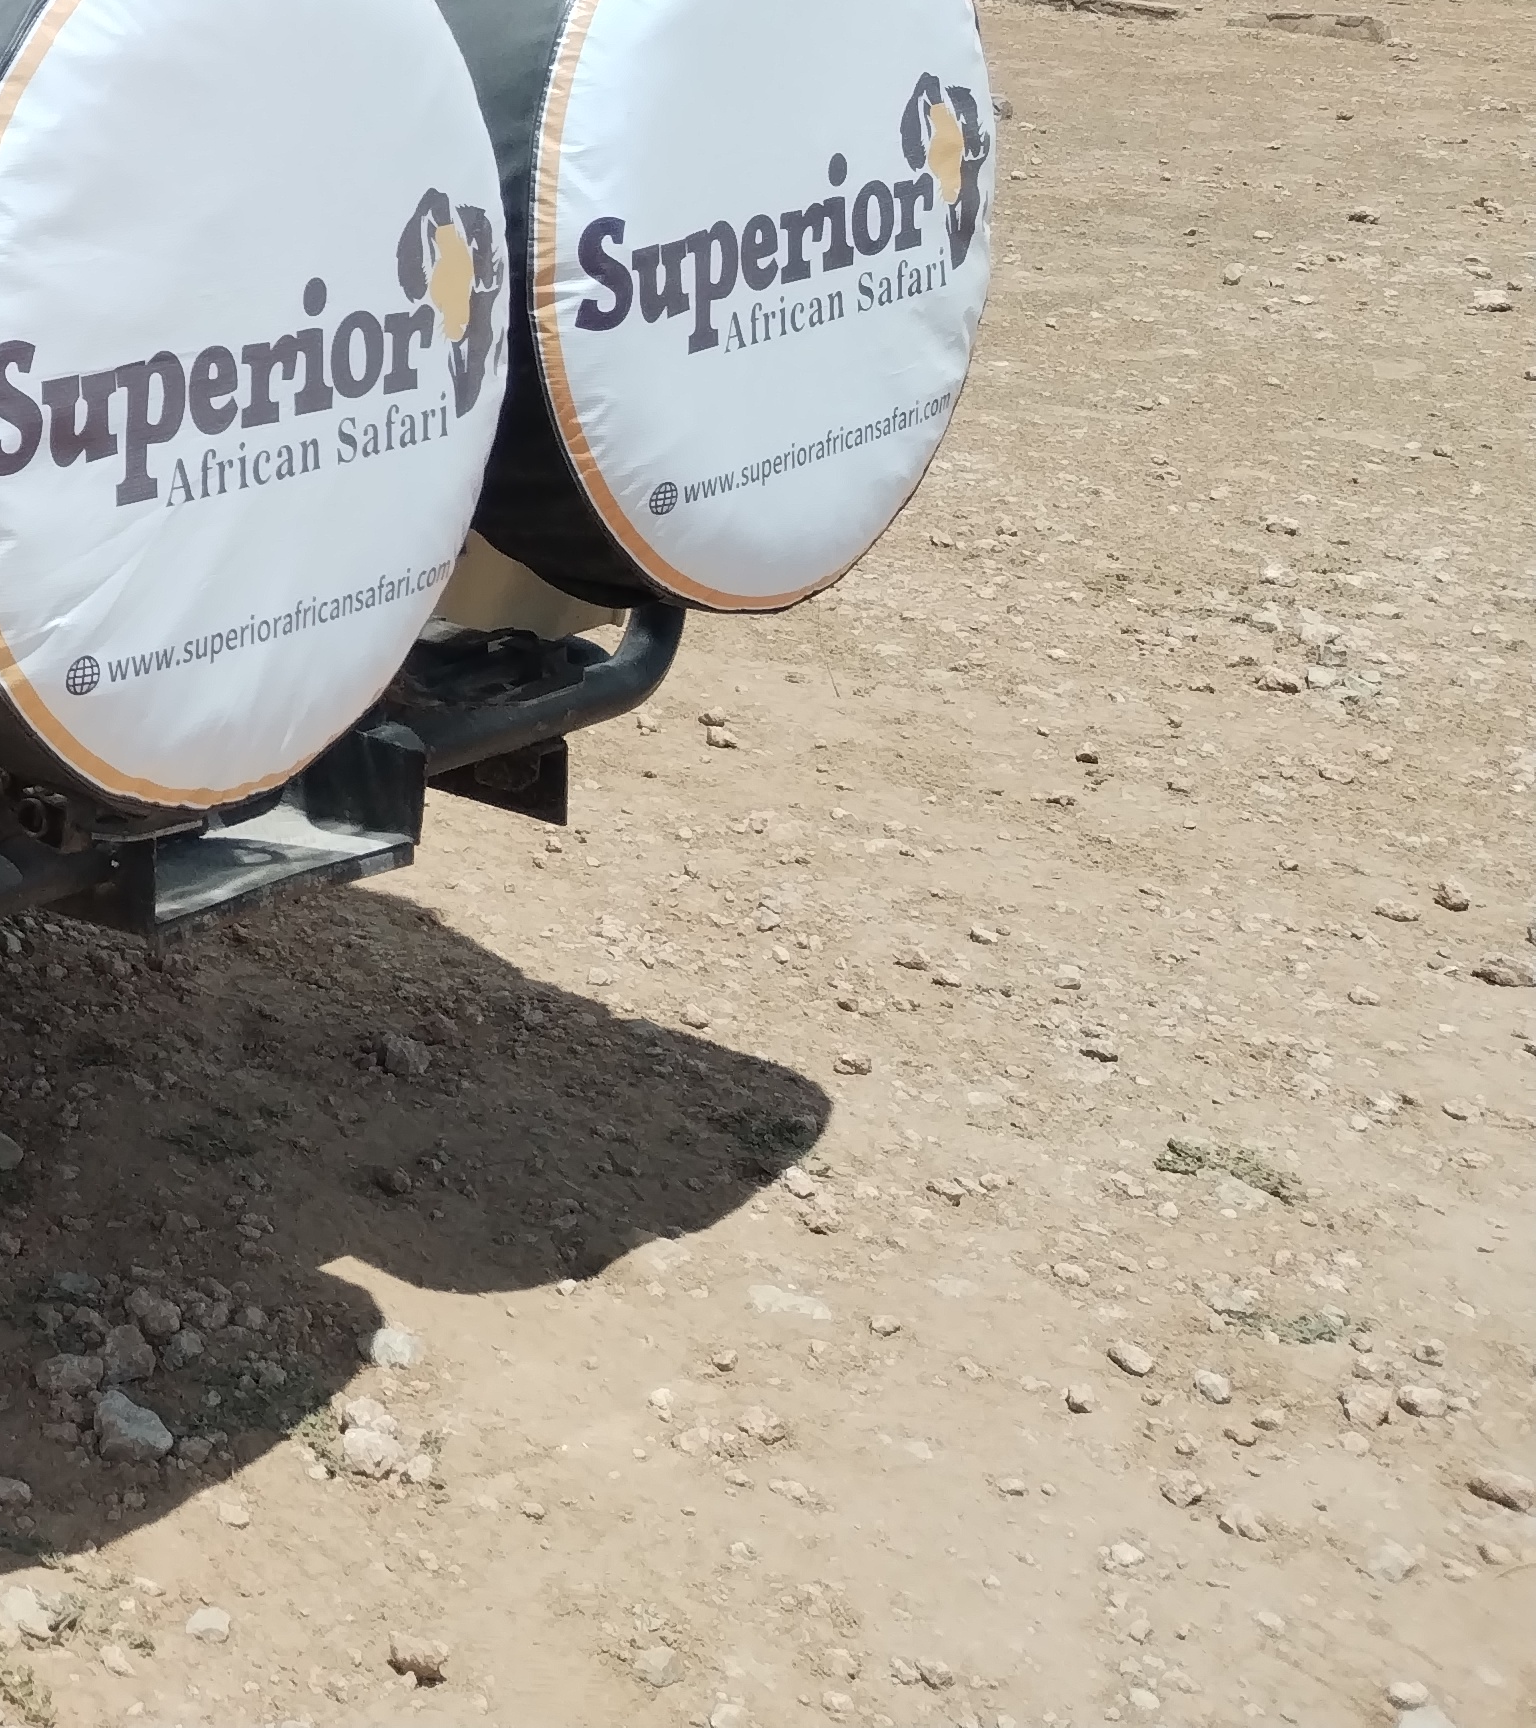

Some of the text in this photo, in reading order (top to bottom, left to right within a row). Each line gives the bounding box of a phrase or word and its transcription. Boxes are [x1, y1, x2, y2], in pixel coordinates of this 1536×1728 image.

[573, 152, 934, 356] Superior
[723, 247, 949, 354] African Safari
[164, 392, 451, 508] African Safari
[683, 390, 953, 505] www.superiorafricansafari.com
[107, 558, 452, 684] www.superiorafricansafari.com
